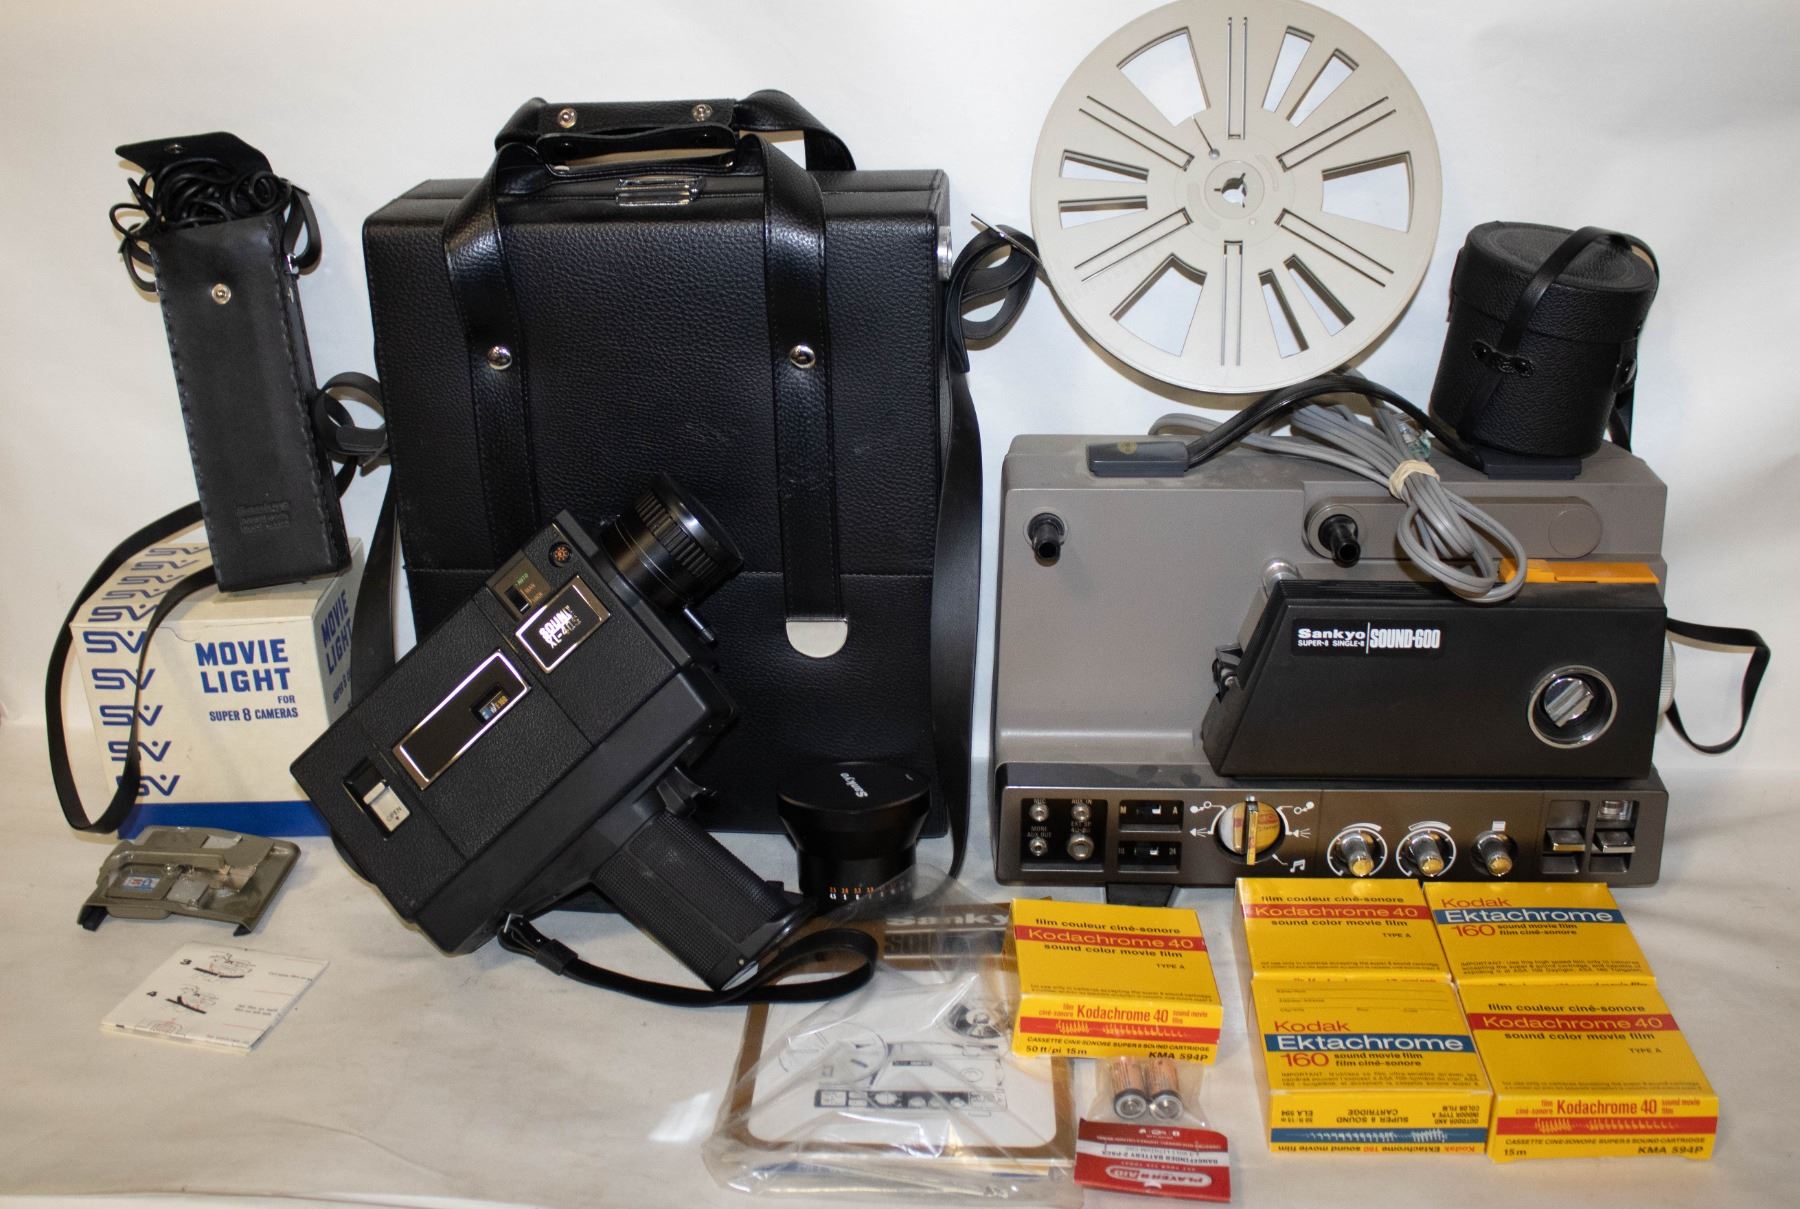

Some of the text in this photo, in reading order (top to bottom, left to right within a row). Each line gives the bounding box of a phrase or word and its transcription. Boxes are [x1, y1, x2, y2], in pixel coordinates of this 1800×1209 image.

[321, 590, 349, 649] MOVIE
[1297, 628, 1366, 640] Sankyo
[1370, 629, 1441, 649] SOUND-600
[195, 638, 289, 666] MOVIE
[326, 618, 351, 675] LIGHT
[200, 667, 291, 693] LIGHT
[277, 695, 295, 704] FOR
[209, 707, 298, 722] SUPER 8 CAMERAS
[1172, 806, 1179, 814] A
[1441, 898, 1512, 907] Kodak
[1255, 906, 1418, 918] Kodachrome 40
[1444, 909, 1613, 923] Ektachrome
[886, 913, 1008, 926] Sanky
[1035, 918, 1058, 926] film
[1061, 920, 1106, 930] couleur
[1312, 919, 1343, 927] color
[1451, 925, 1496, 937] 160
[1028, 928, 1194, 949] Kodachrome 40
[1044, 943, 1183, 958] sound color movie film
[1077, 1004, 1169, 1023] Kodachrome 40
[1488, 1003, 1512, 1011] film
[1516, 1004, 1564, 1012] couleur
[1274, 1021, 1351, 1032] Kodak
[1482, 1016, 1663, 1030] Kodachrome 40
[1027, 1036, 1062, 1044] CASSETTE
[1504, 1032, 1655, 1040] sound color movie film
[1026, 1045, 1039, 1053] 50
[1277, 1035, 1464, 1051] Ektachrome
[1149, 1052, 1208, 1061] KMA 594P
[1280, 1053, 1329, 1067] 160
[1402, 1052, 1423, 1060] film
[1557, 1099, 1657, 1115] Kodachrome 40
[1637, 1146, 1704, 1154] KMA 594P
